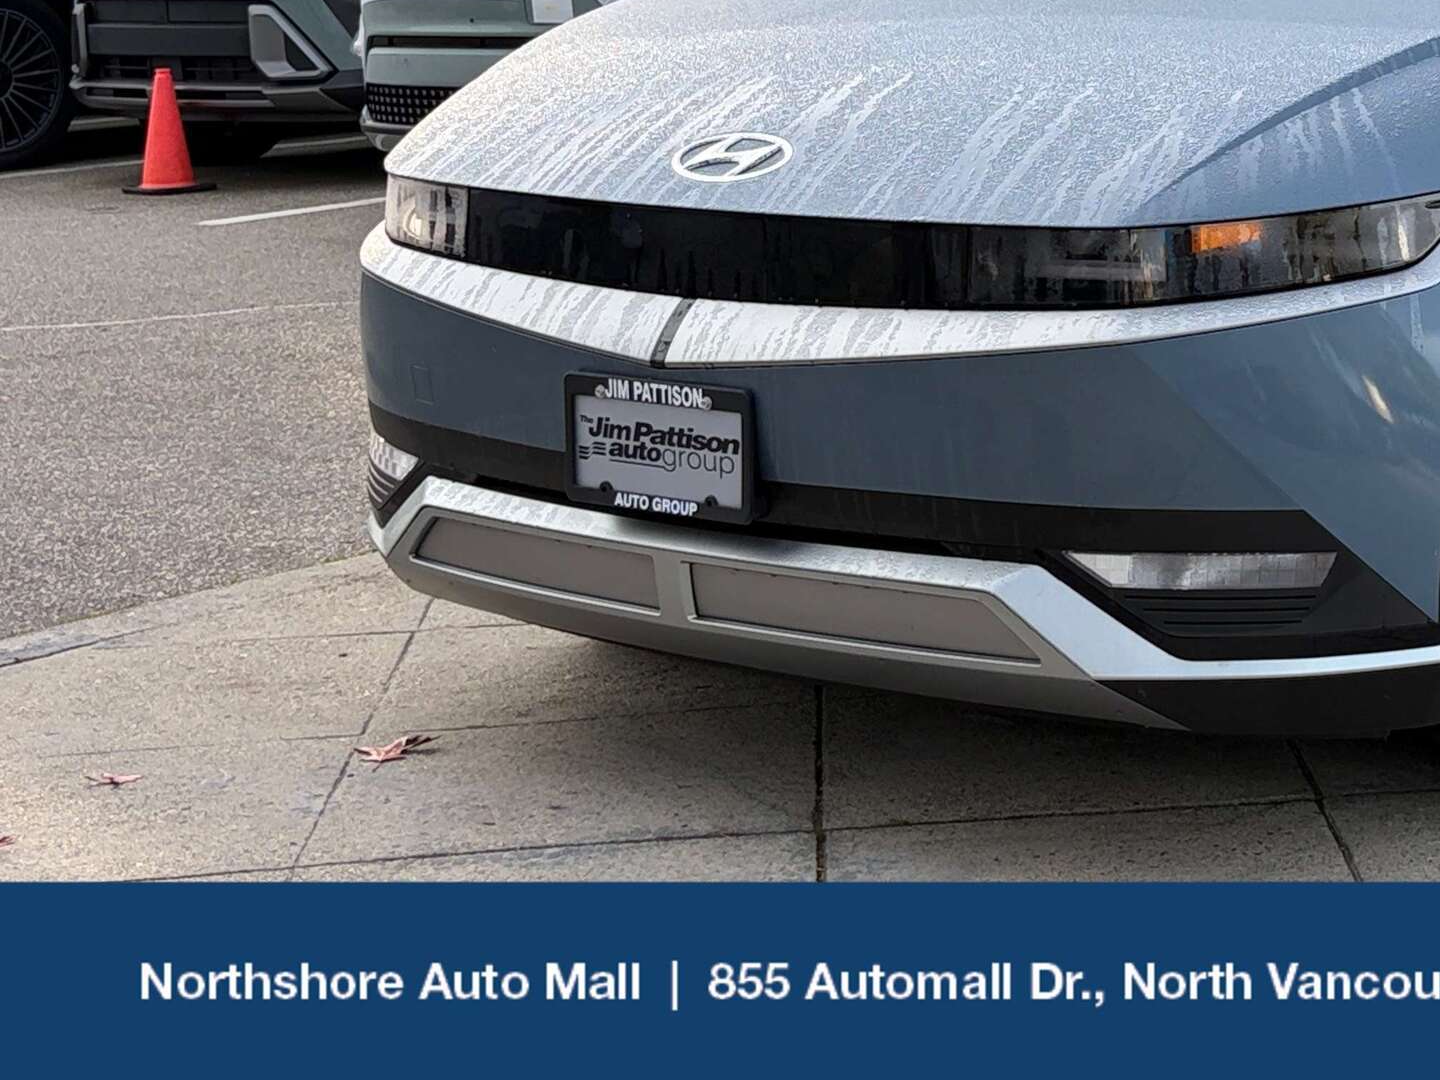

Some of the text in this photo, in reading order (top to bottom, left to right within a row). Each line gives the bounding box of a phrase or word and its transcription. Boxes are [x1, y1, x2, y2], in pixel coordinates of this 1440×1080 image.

[604, 378, 703, 408] JIM PATTISON
[588, 416, 632, 441] Jim
[632, 421, 740, 455] Pattison
[614, 492, 698, 517] AUTO GROUP
